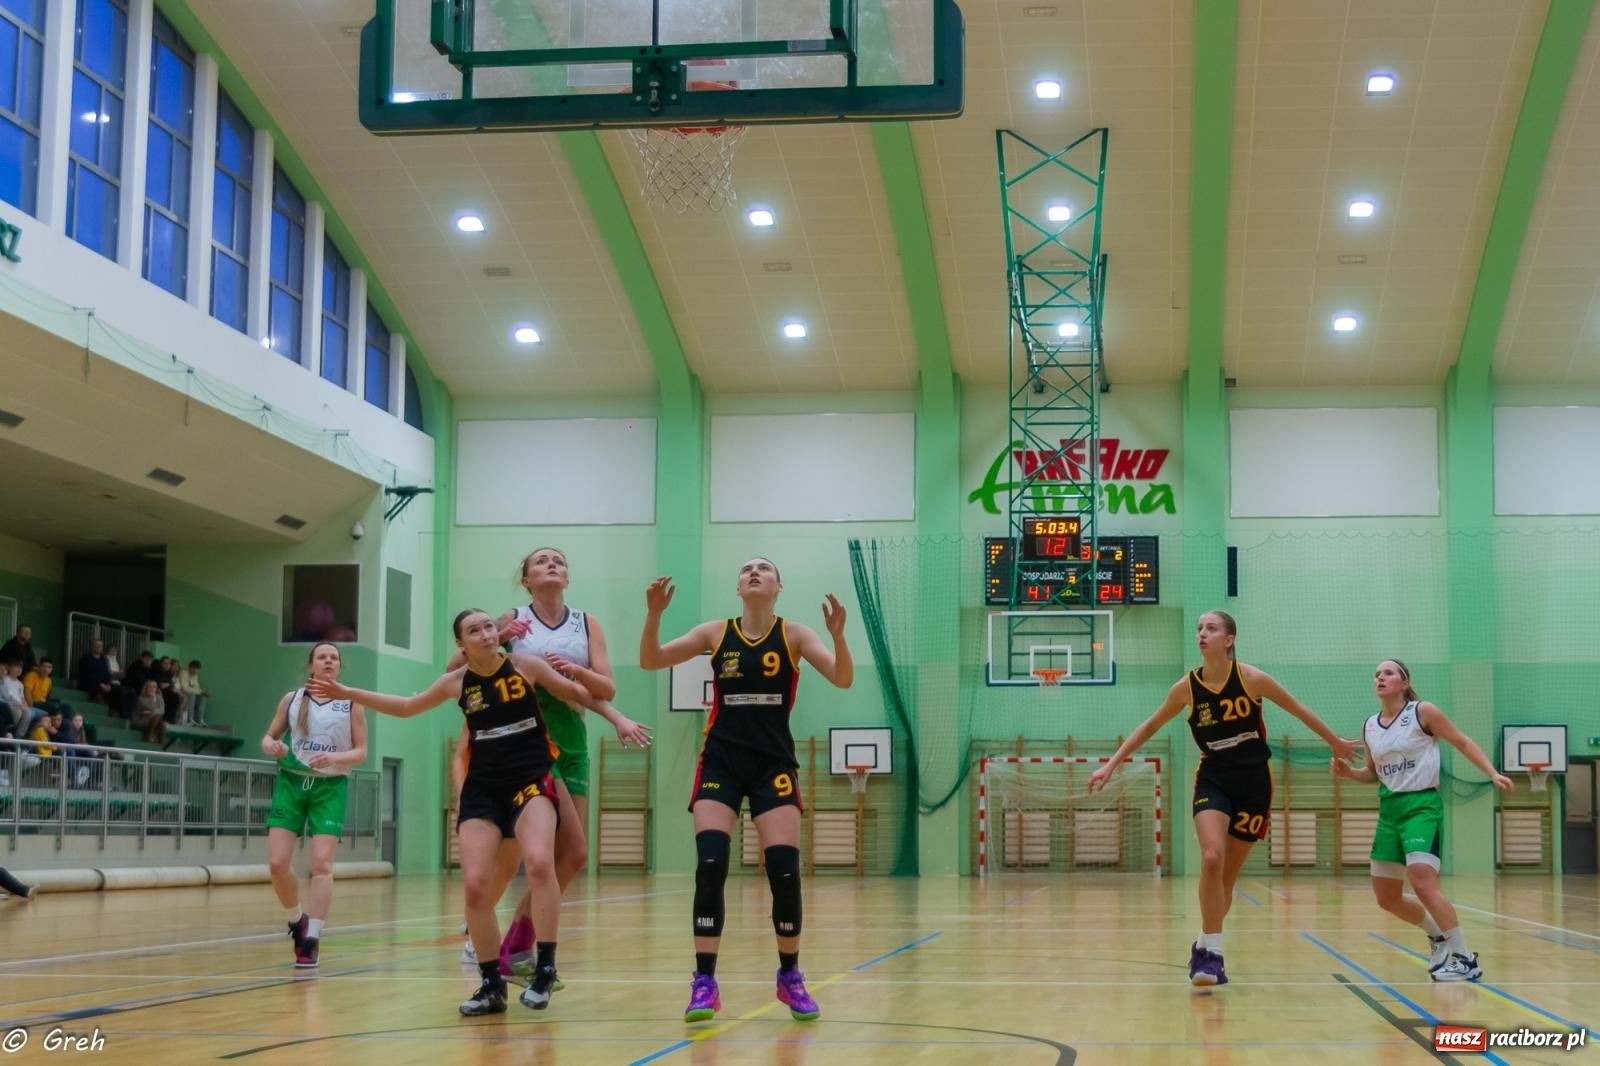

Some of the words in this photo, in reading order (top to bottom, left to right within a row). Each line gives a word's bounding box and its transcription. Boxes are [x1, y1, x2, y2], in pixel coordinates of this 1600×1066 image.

[968, 440, 1177, 514] Arena
[1045, 536, 1066, 555] 12
[1100, 585, 1122, 601] 24
[763, 651, 780, 677] 9
[495, 675, 527, 702] 13
[1219, 696, 1250, 721] 20
[302, 741, 338, 753] Clavis
[1382, 759, 1416, 776] Clavis
[774, 773, 793, 797] 9
[1233, 812, 1264, 834] 20
